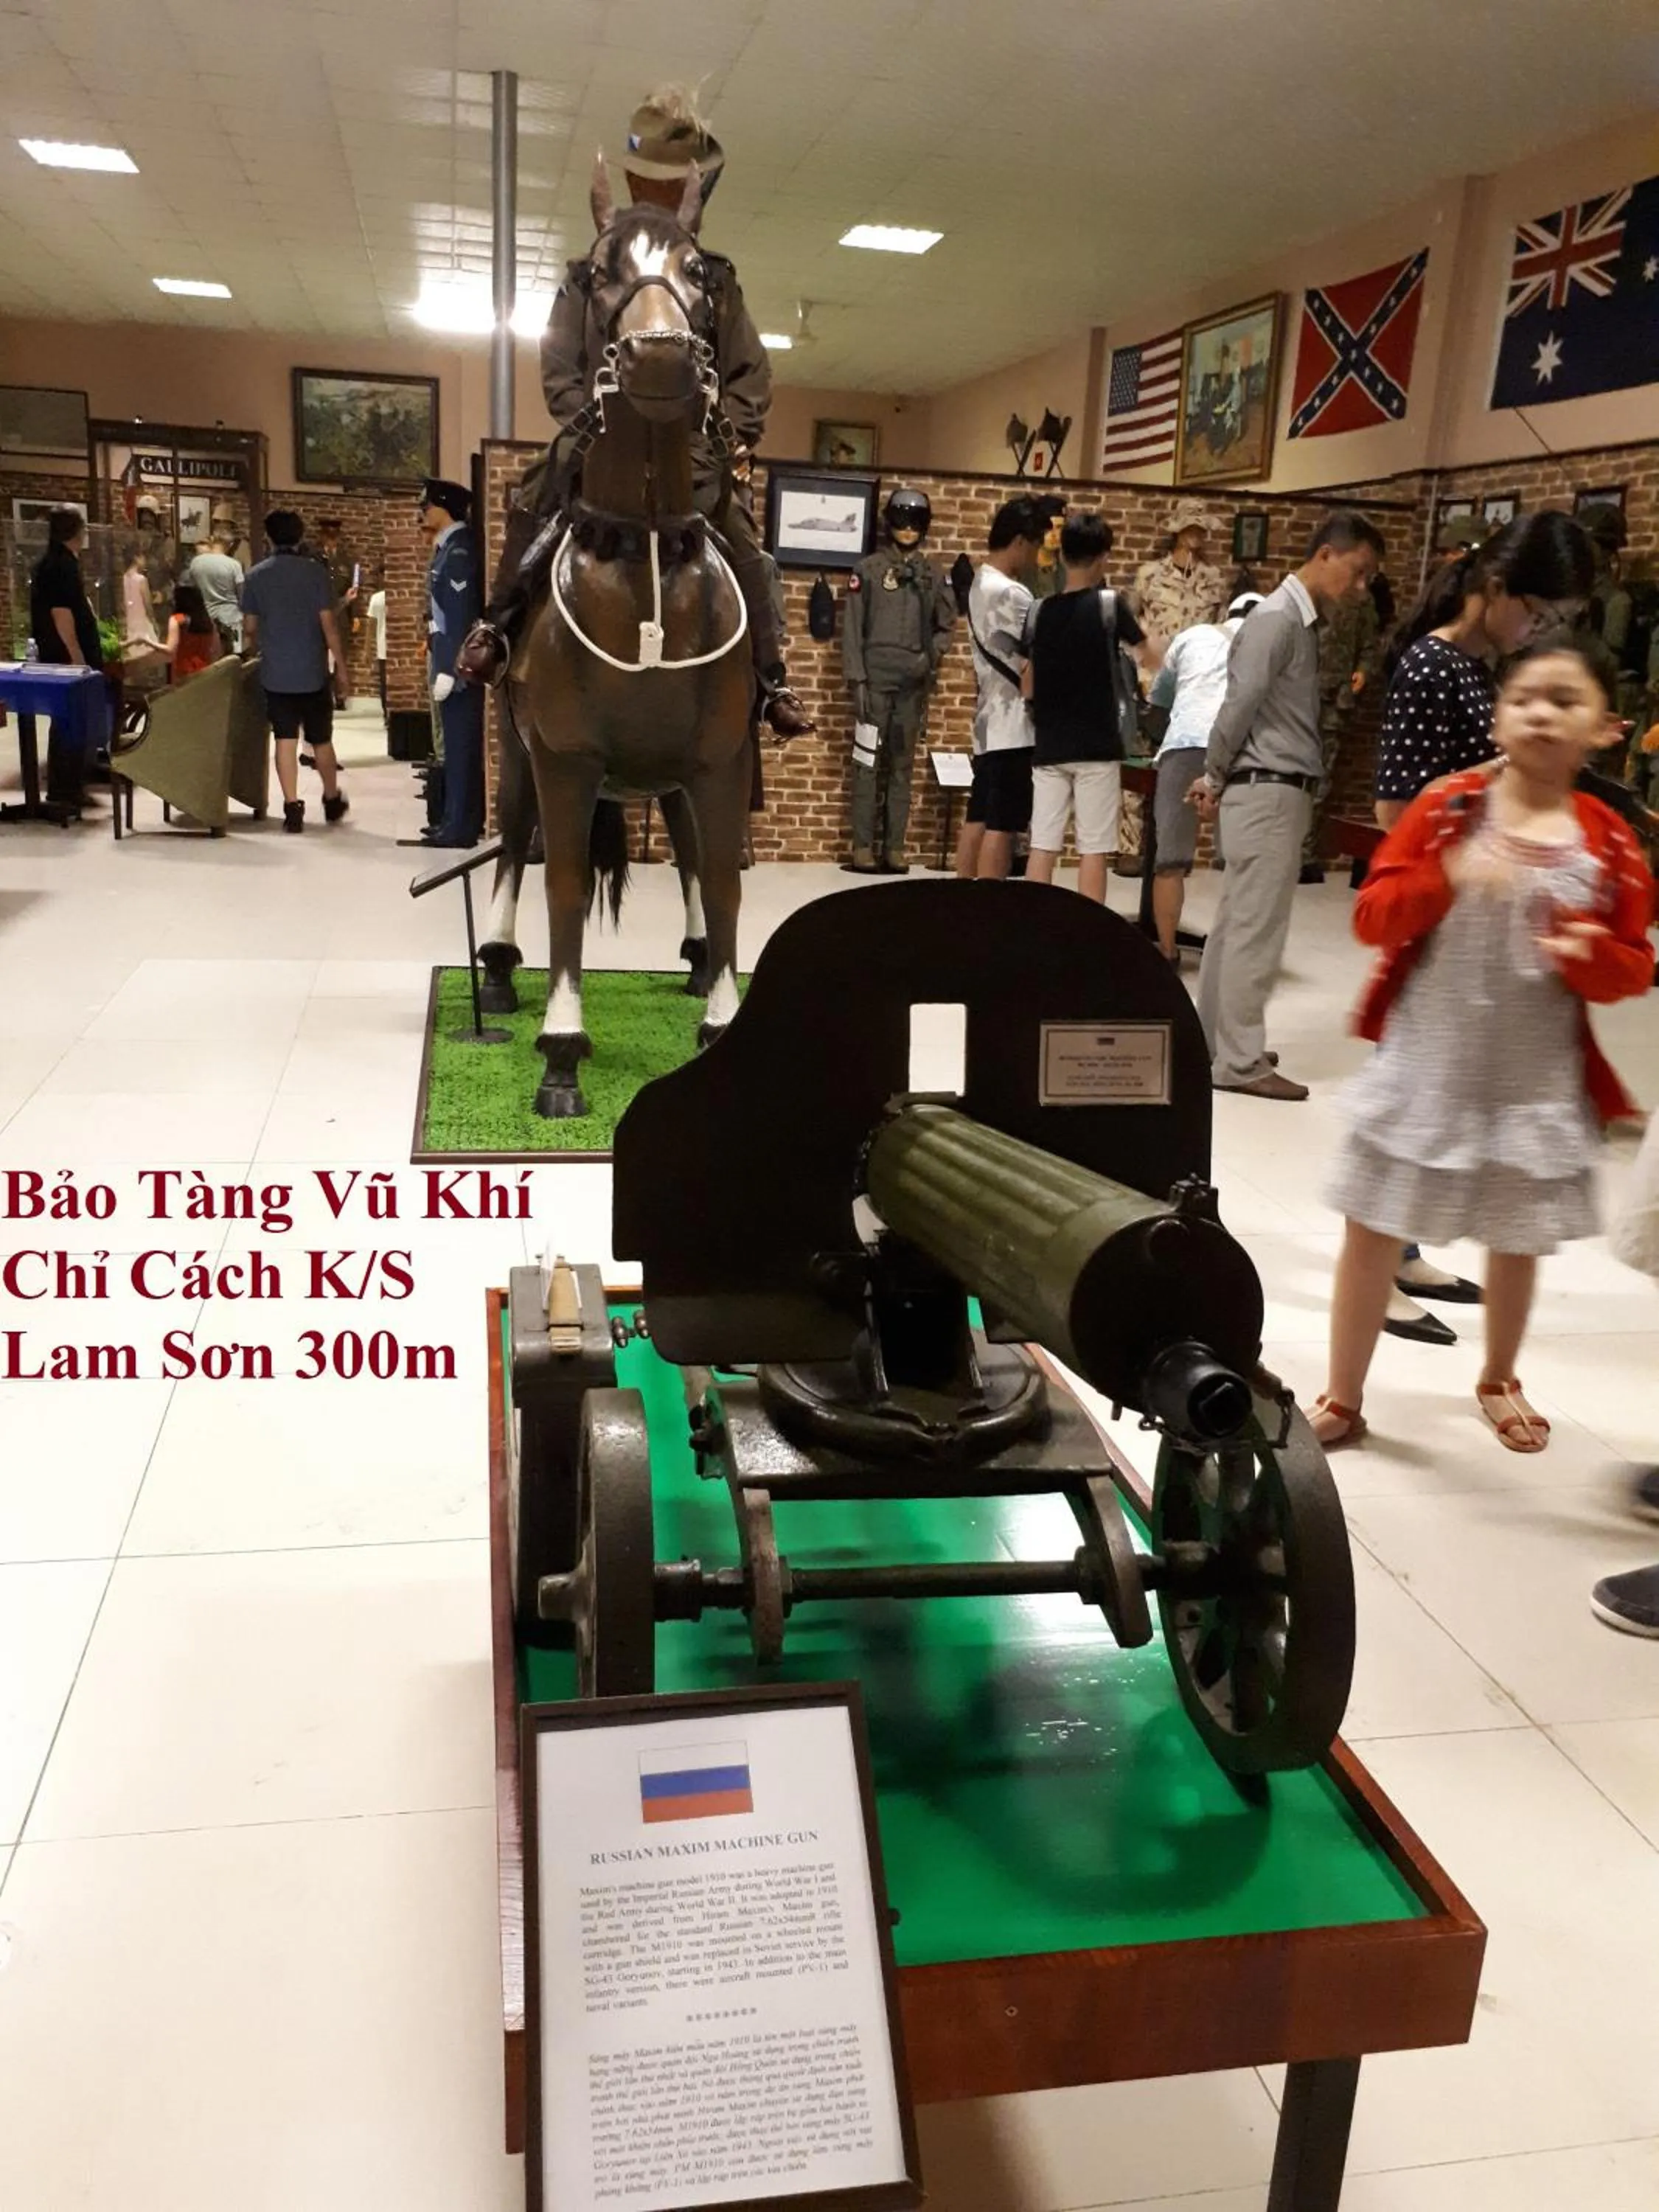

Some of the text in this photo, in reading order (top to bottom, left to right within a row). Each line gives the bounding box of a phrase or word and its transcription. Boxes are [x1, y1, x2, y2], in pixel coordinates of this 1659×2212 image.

[588, 1831, 818, 1865] RUSSIAN MAXIM MACHINE GUN
[728, 1872, 745, 1880] was
[780, 1863, 816, 1875] machine
[597, 1909, 615, 1919] Red
[619, 1906, 642, 1919] Army
[644, 1902, 674, 1916] during
[677, 1899, 704, 1910] World
[707, 1896, 725, 1907] War
[750, 1894, 768, 1902] was
[768, 1888, 803, 1902] adopted
[602, 1896, 612, 1907] by
[616, 1894, 630, 1905] the
[707, 1883, 731, 1896] Army
[733, 1880, 763, 1893] during
[764, 1877, 792, 1889] World
[819, 1872, 836, 1883] and
[581, 1924, 598, 1933] and
[606, 1922, 625, 1930] was
[631, 1916, 664, 1928] derived
[672, 1913, 694, 1924] from
[636, 1930, 650, 1941] for
[655, 1928, 670, 1938] the
[584, 1961, 604, 1972] with
[614, 1961, 632, 1971] gun
[634, 1955, 661, 1966] shield
[663, 1953, 681, 1964] and
[682, 1952, 700, 1961] was
[742, 1945, 752, 1954] in
[754, 1941, 782, 1953] Soviet
[815, 1936, 828, 1947] by
[830, 1934, 846, 1944] the
[687, 1939, 704, 1947] was
[709, 1933, 747, 1945] mounted
[664, 1979, 688, 1990] there
[692, 1978, 714, 1986] were
[755, 1966, 793, 1979] mounted
[832, 1960, 849, 1970] and
[667, 1964, 701, 1978] starting
[703, 1963, 713, 1972] in
[807, 1950, 821, 1960] the
